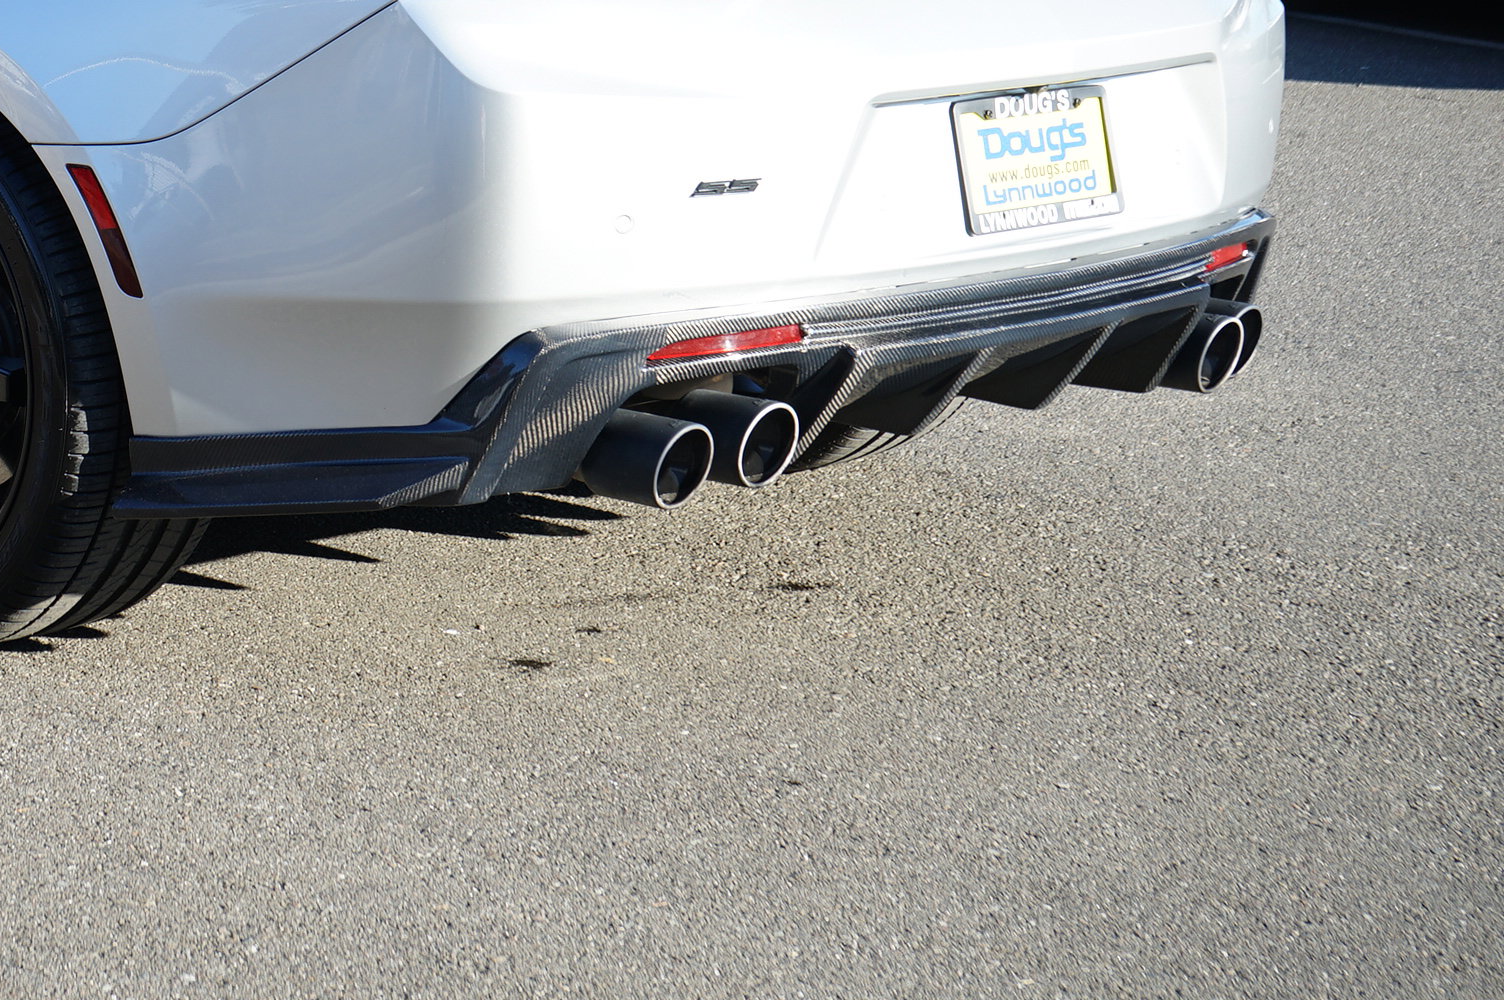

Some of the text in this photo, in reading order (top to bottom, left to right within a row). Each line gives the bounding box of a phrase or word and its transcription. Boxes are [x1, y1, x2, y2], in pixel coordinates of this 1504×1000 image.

[994, 89, 1070, 118] DOUG'S
[977, 118, 1087, 162] Doug's
[988, 159, 1090, 183] www.dougs.com
[689, 178, 762, 198] SS
[983, 169, 1097, 206] Lynnwood
[978, 203, 1059, 234] LYNNWOOD
